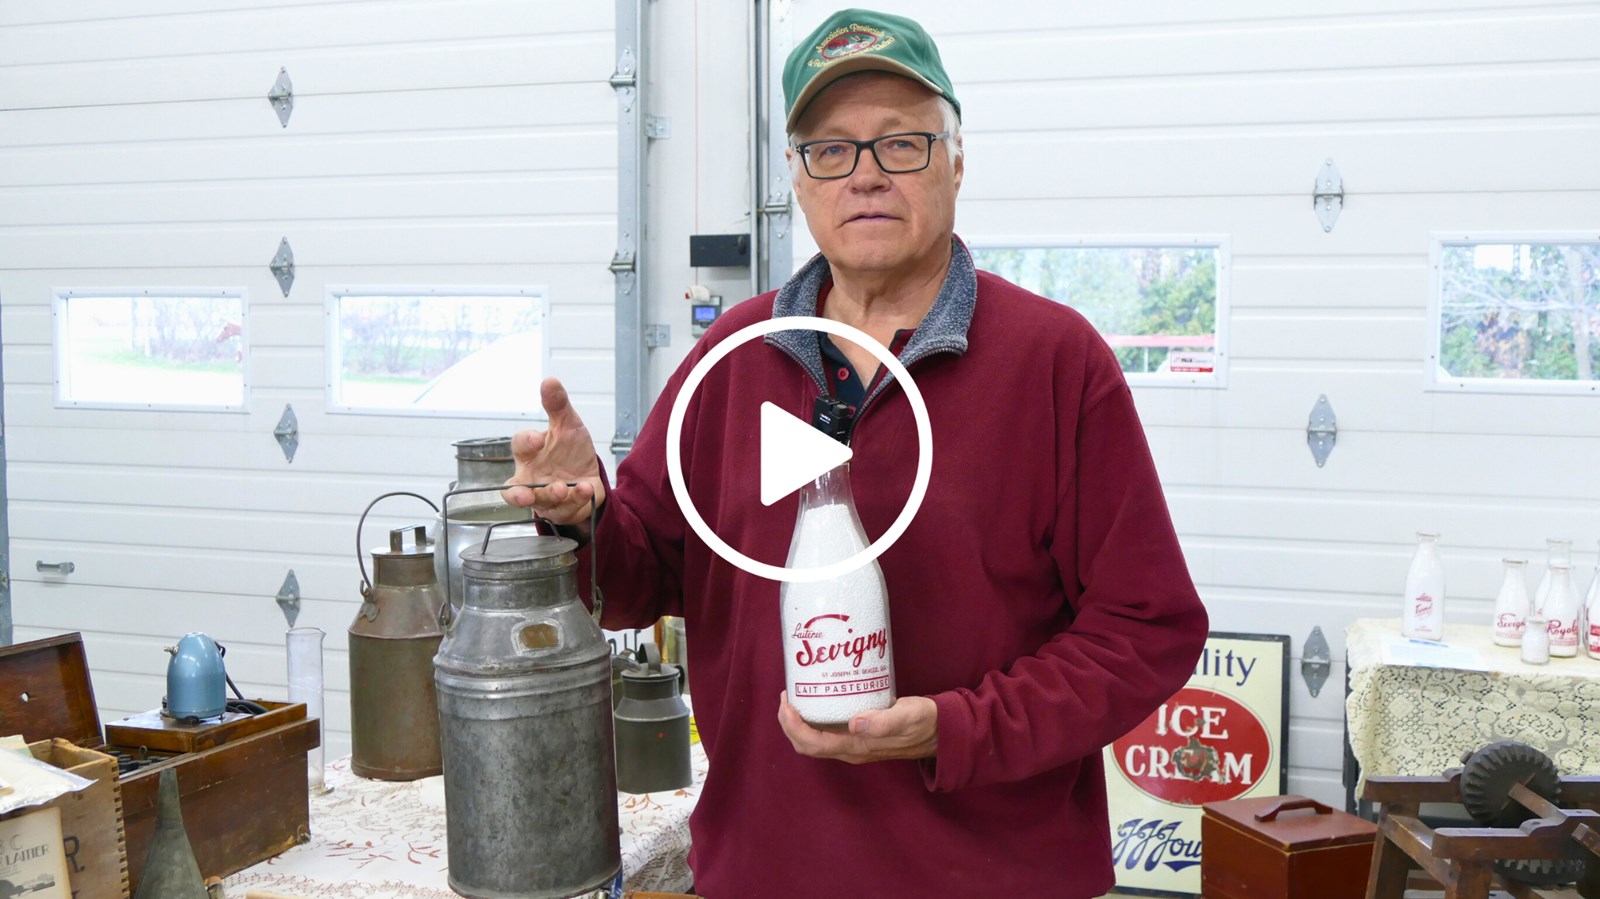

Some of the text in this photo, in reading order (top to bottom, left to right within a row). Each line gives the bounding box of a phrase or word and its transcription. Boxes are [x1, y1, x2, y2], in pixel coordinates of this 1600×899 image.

[796, 614, 887, 668] Sevigny
[1193, 648, 1257, 686] lity
[797, 686, 818, 695] LAIT
[1156, 704, 1230, 740] ICE
